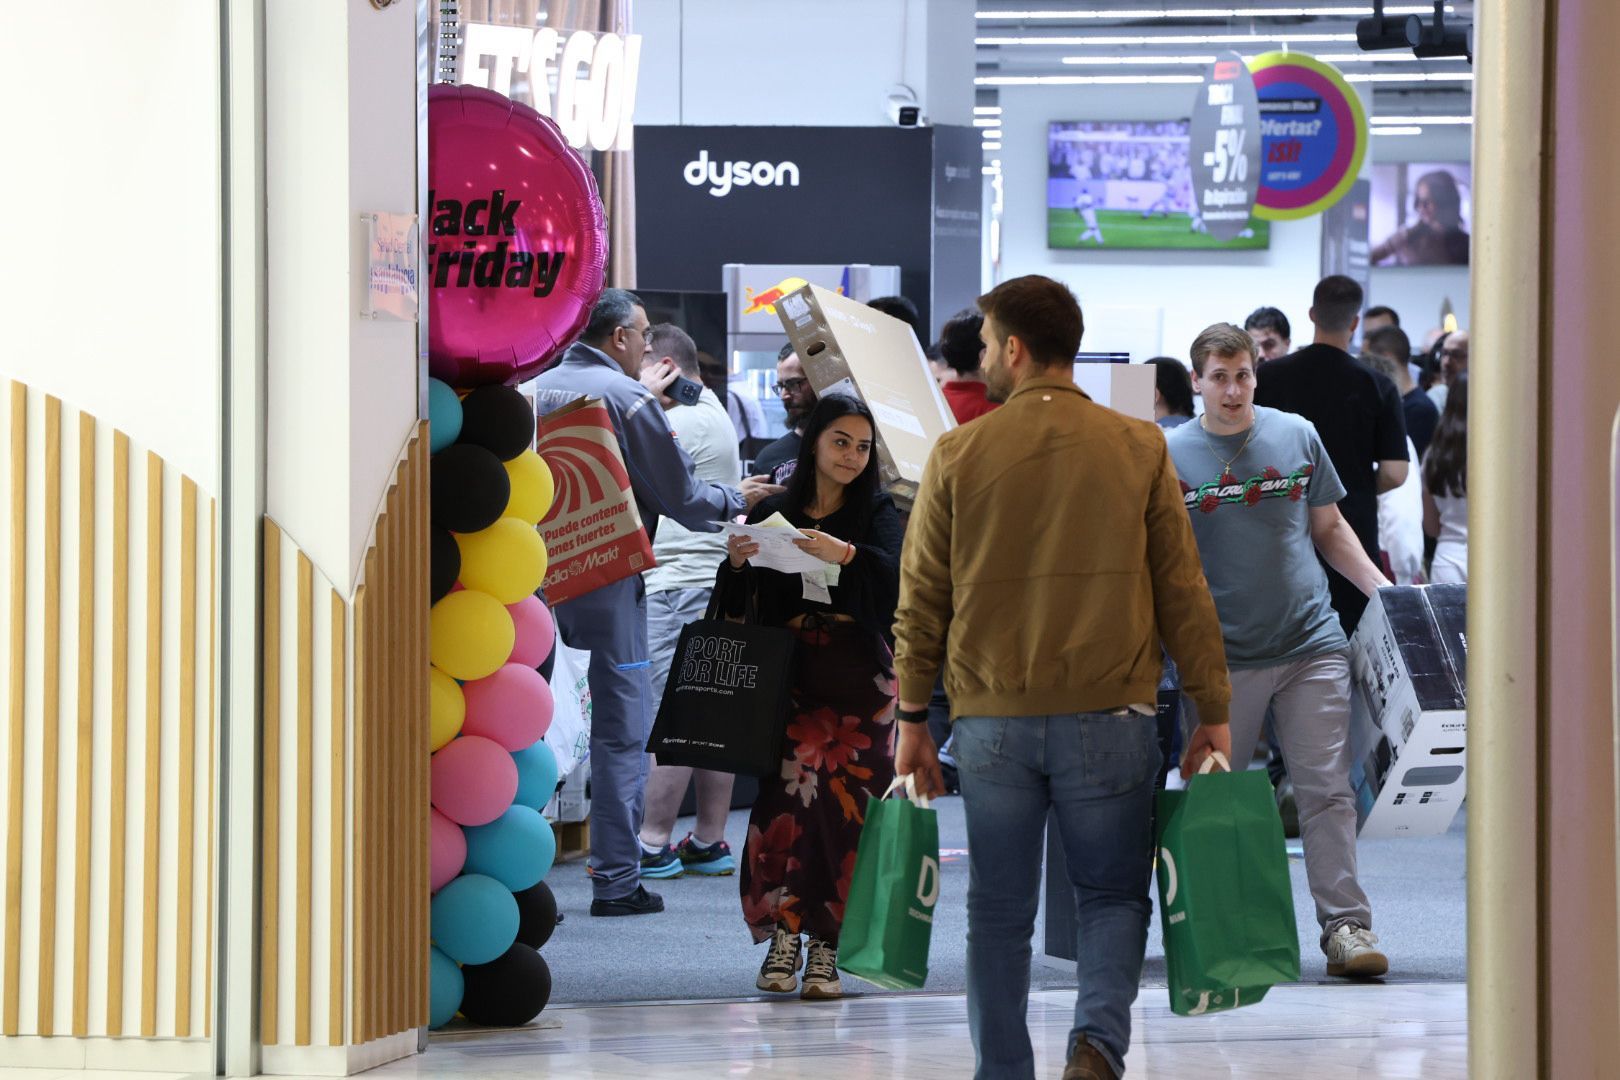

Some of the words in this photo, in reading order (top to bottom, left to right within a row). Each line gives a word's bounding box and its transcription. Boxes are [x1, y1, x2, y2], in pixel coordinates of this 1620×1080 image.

[557, 30, 642, 151] GO!
[684, 150, 800, 197] dyson
[1203, 128, 1249, 183] -5%
[545, 520, 579, 543] Puede
[580, 500, 629, 528] contener
[546, 540, 575, 558] ones
[576, 523, 616, 546] fuertes
[581, 545, 620, 572] Markt
[714, 661, 759, 689] LIFE
[916, 854, 940, 907] D
